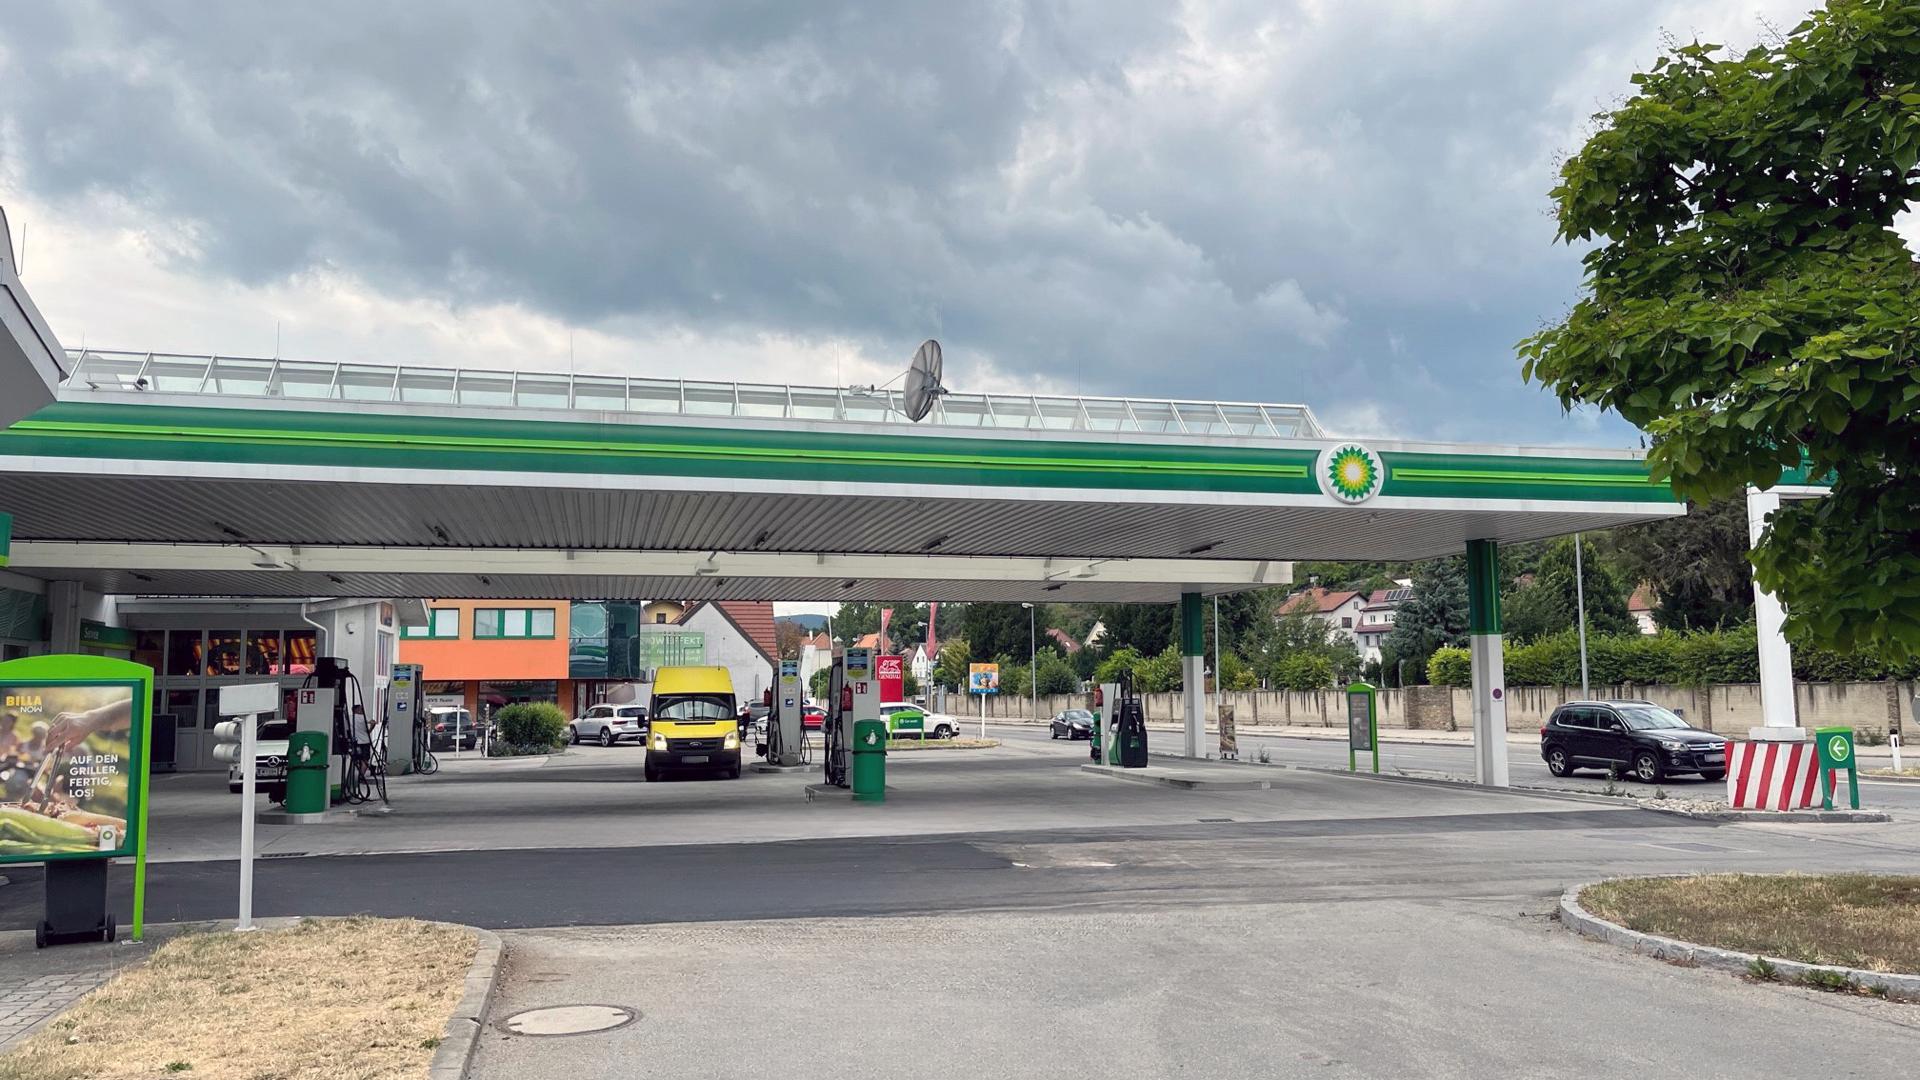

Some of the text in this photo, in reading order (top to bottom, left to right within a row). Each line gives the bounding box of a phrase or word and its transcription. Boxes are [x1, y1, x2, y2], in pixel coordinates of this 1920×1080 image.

[6, 695, 42, 705] BILLA
[70, 754, 119, 765] AUF DEN
[69, 765, 119, 776] GRILLER,
[69, 776, 112, 787] FERTIG,
[69, 788, 95, 798] LOS!
